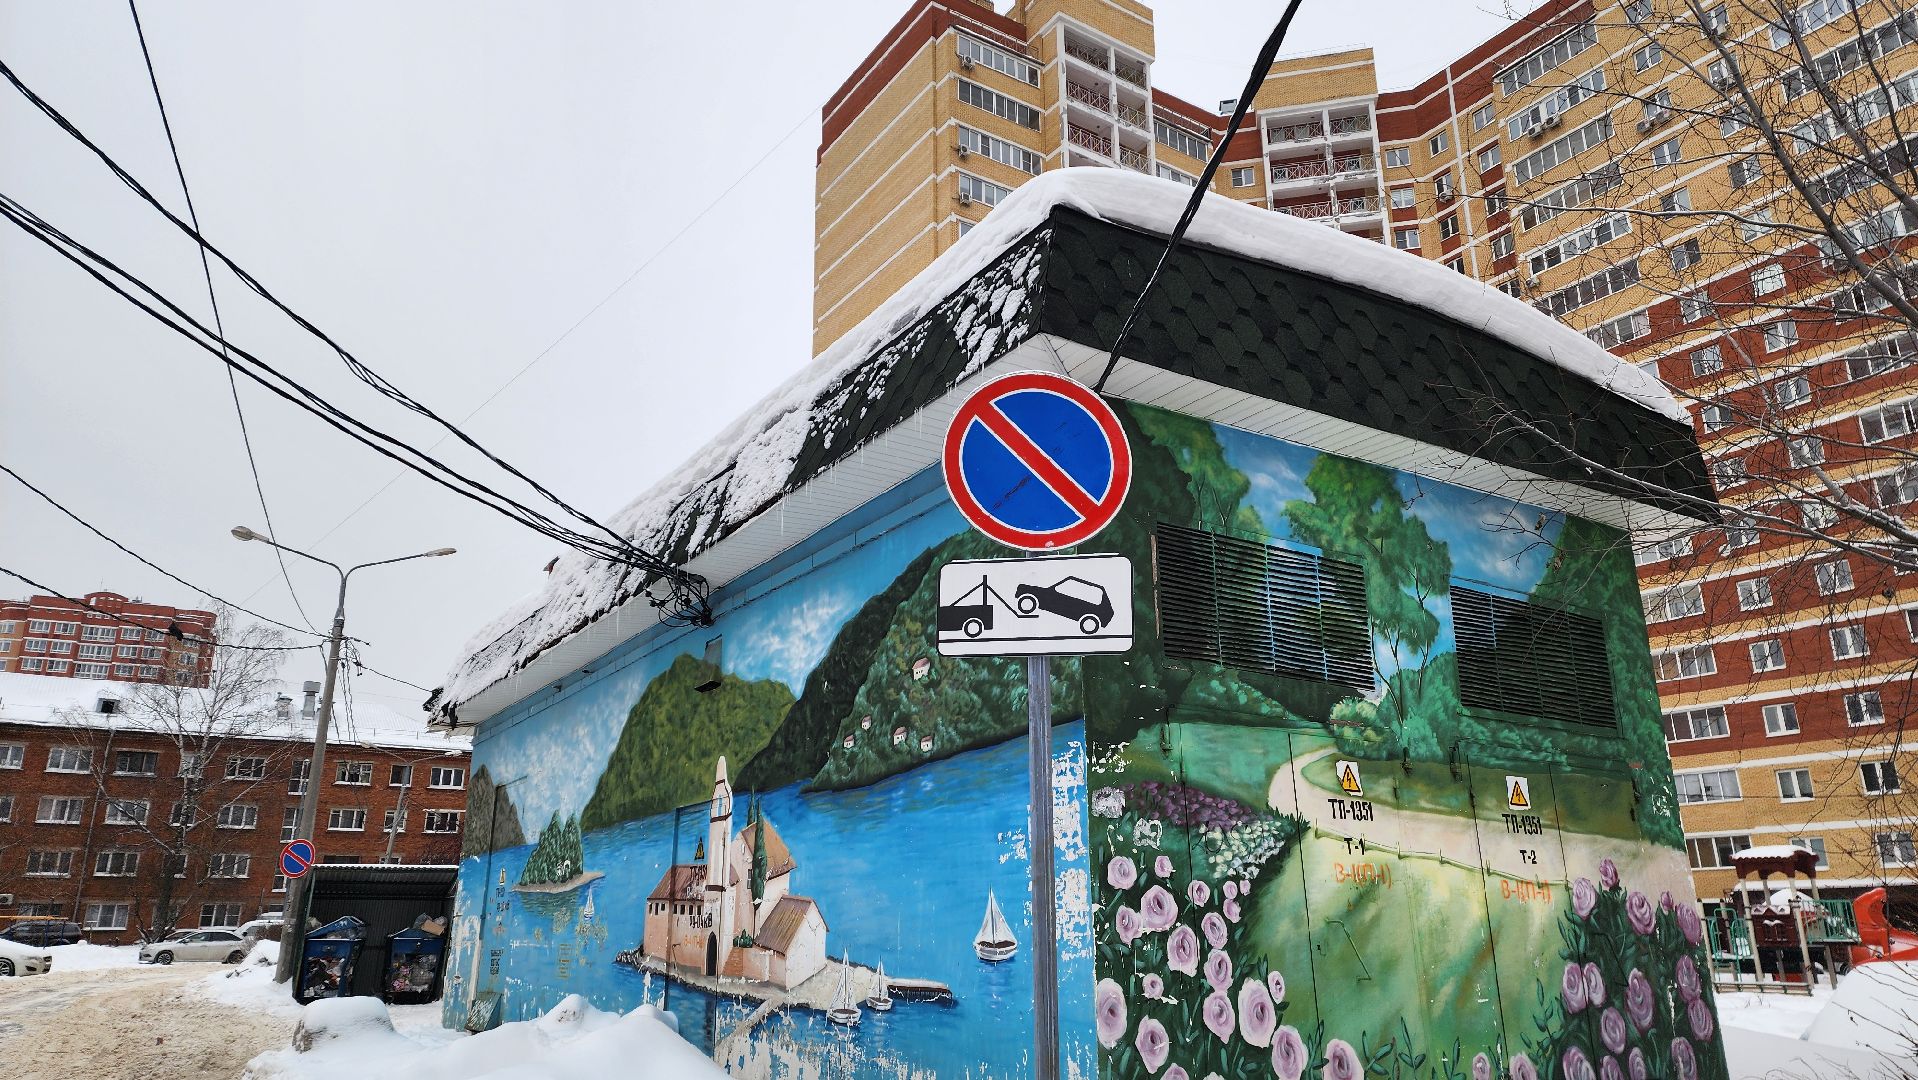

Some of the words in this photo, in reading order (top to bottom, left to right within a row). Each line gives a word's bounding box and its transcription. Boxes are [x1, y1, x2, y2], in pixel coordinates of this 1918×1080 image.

[1328, 799, 1373, 821] ТП-1351
[1502, 814, 1542, 835] ТП-1351
[1519, 850, 1537, 864] Т-2
